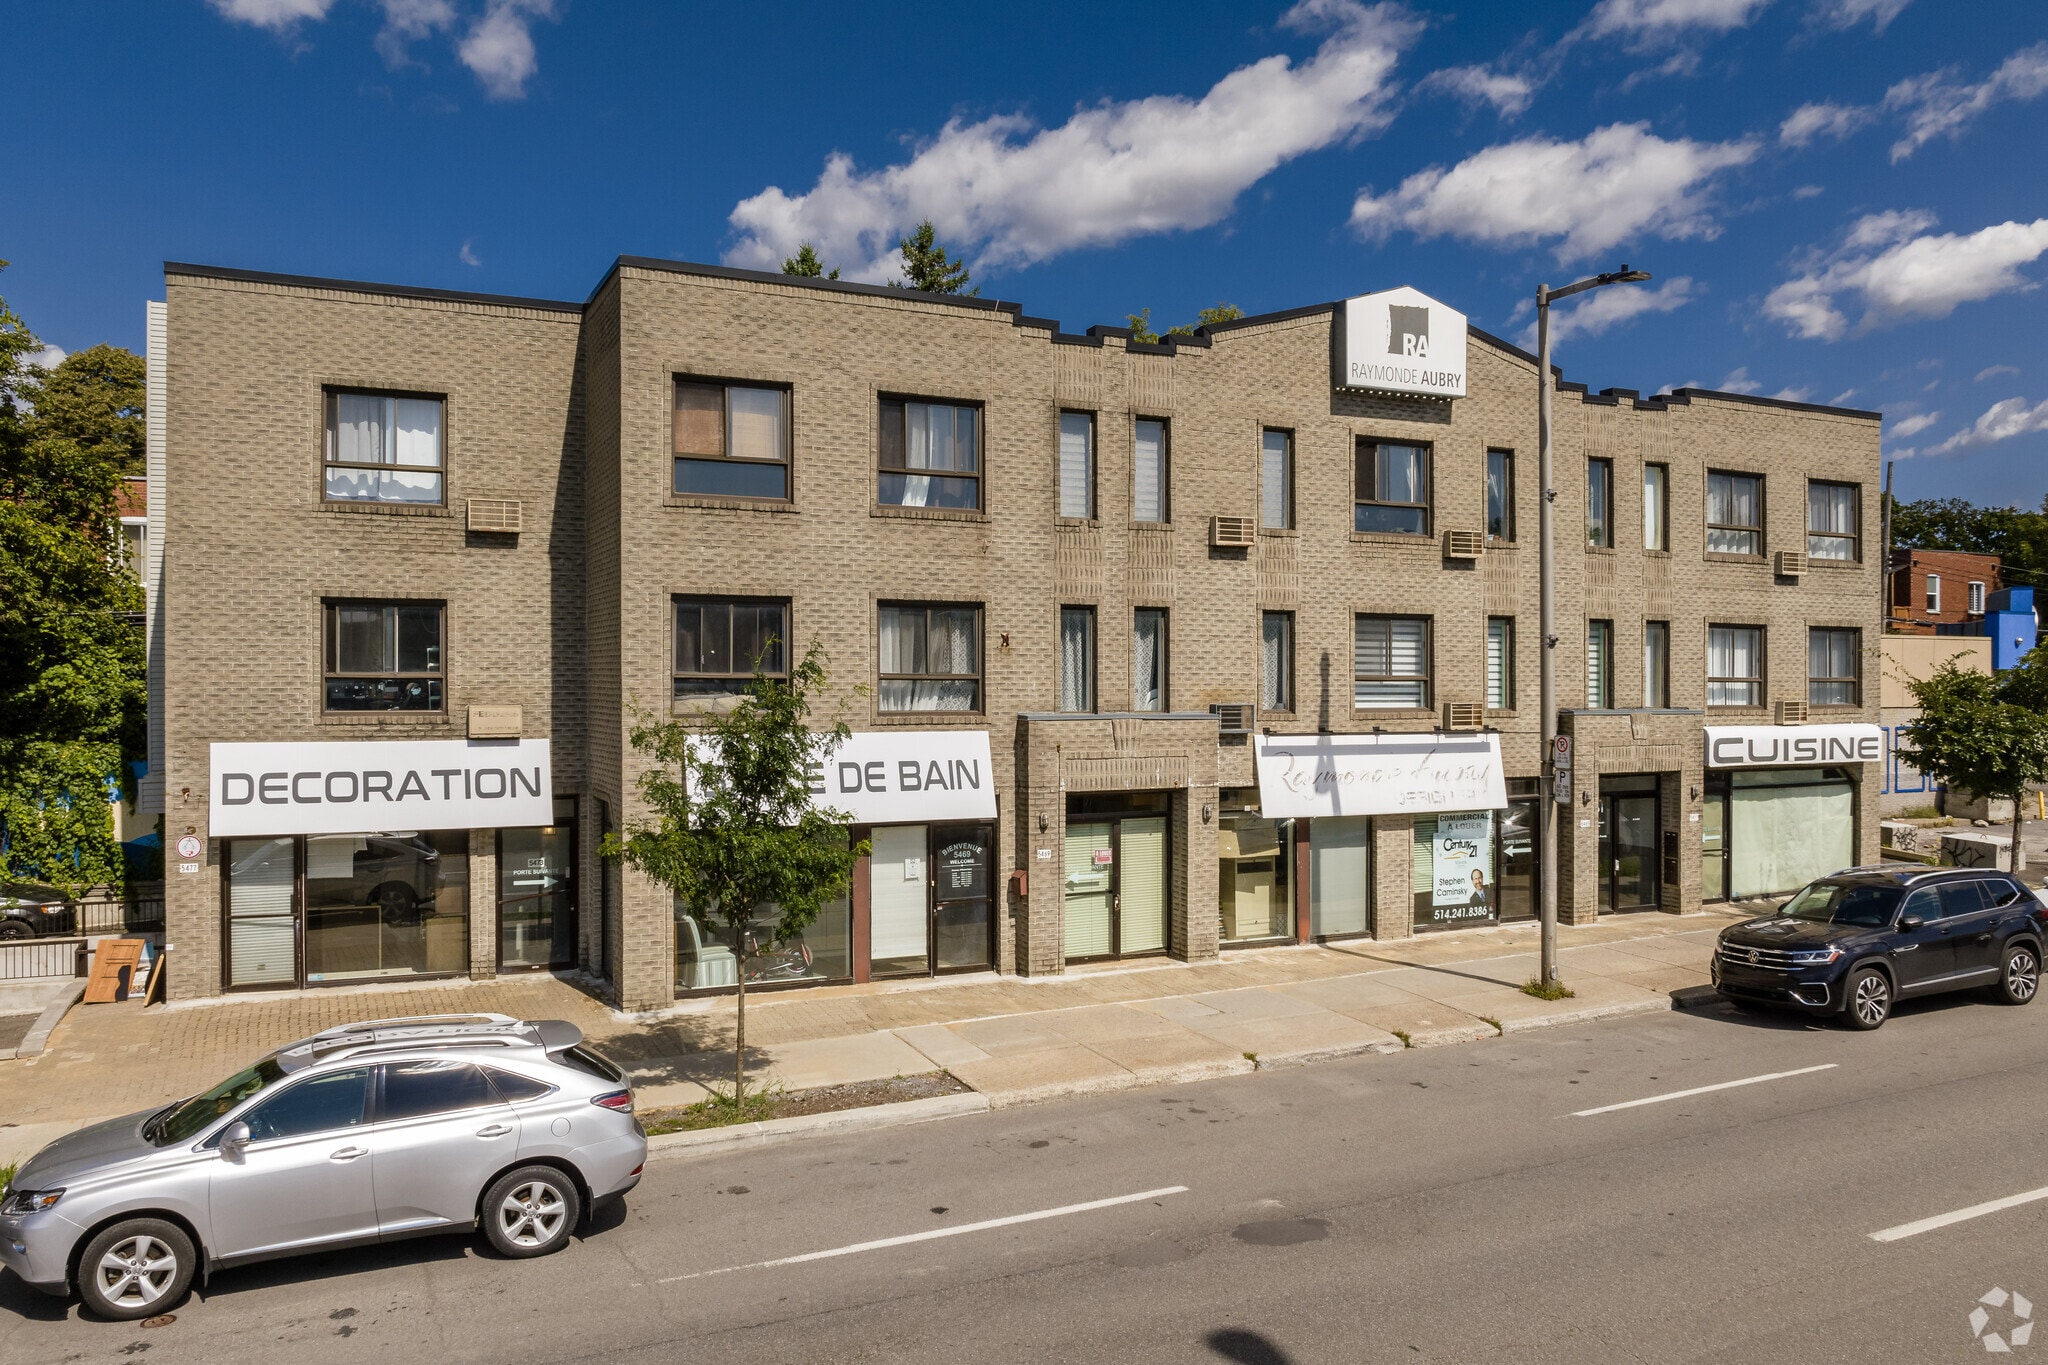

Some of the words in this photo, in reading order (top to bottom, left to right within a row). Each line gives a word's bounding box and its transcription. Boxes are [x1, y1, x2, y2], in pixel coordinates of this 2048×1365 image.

[1403, 333, 1429, 357] RA
[1351, 362, 1418, 385] RAYMONDE
[1420, 370, 1462, 389] AUBRY
[1713, 736, 1879, 764] CUISINE
[838, 761, 887, 794] DE
[898, 759, 980, 791] BAIN
[1559, 771, 1566, 783] P
[222, 767, 541, 806] DECORATION
[1440, 813, 1490, 822] COMMERCIAL
[1455, 822, 1482, 830] LOUER
[942, 843, 983, 856] BIENVENUE
[953, 850, 971, 859] 5469
[1443, 838, 1472, 852] Century
[1469, 845, 1478, 858] 21
[181, 864, 197, 872] 5477
[1439, 877, 1466, 888] Stephen
[1436, 887, 1468, 897] Caminsky
[1434, 905, 1487, 920] 514.241.8386
